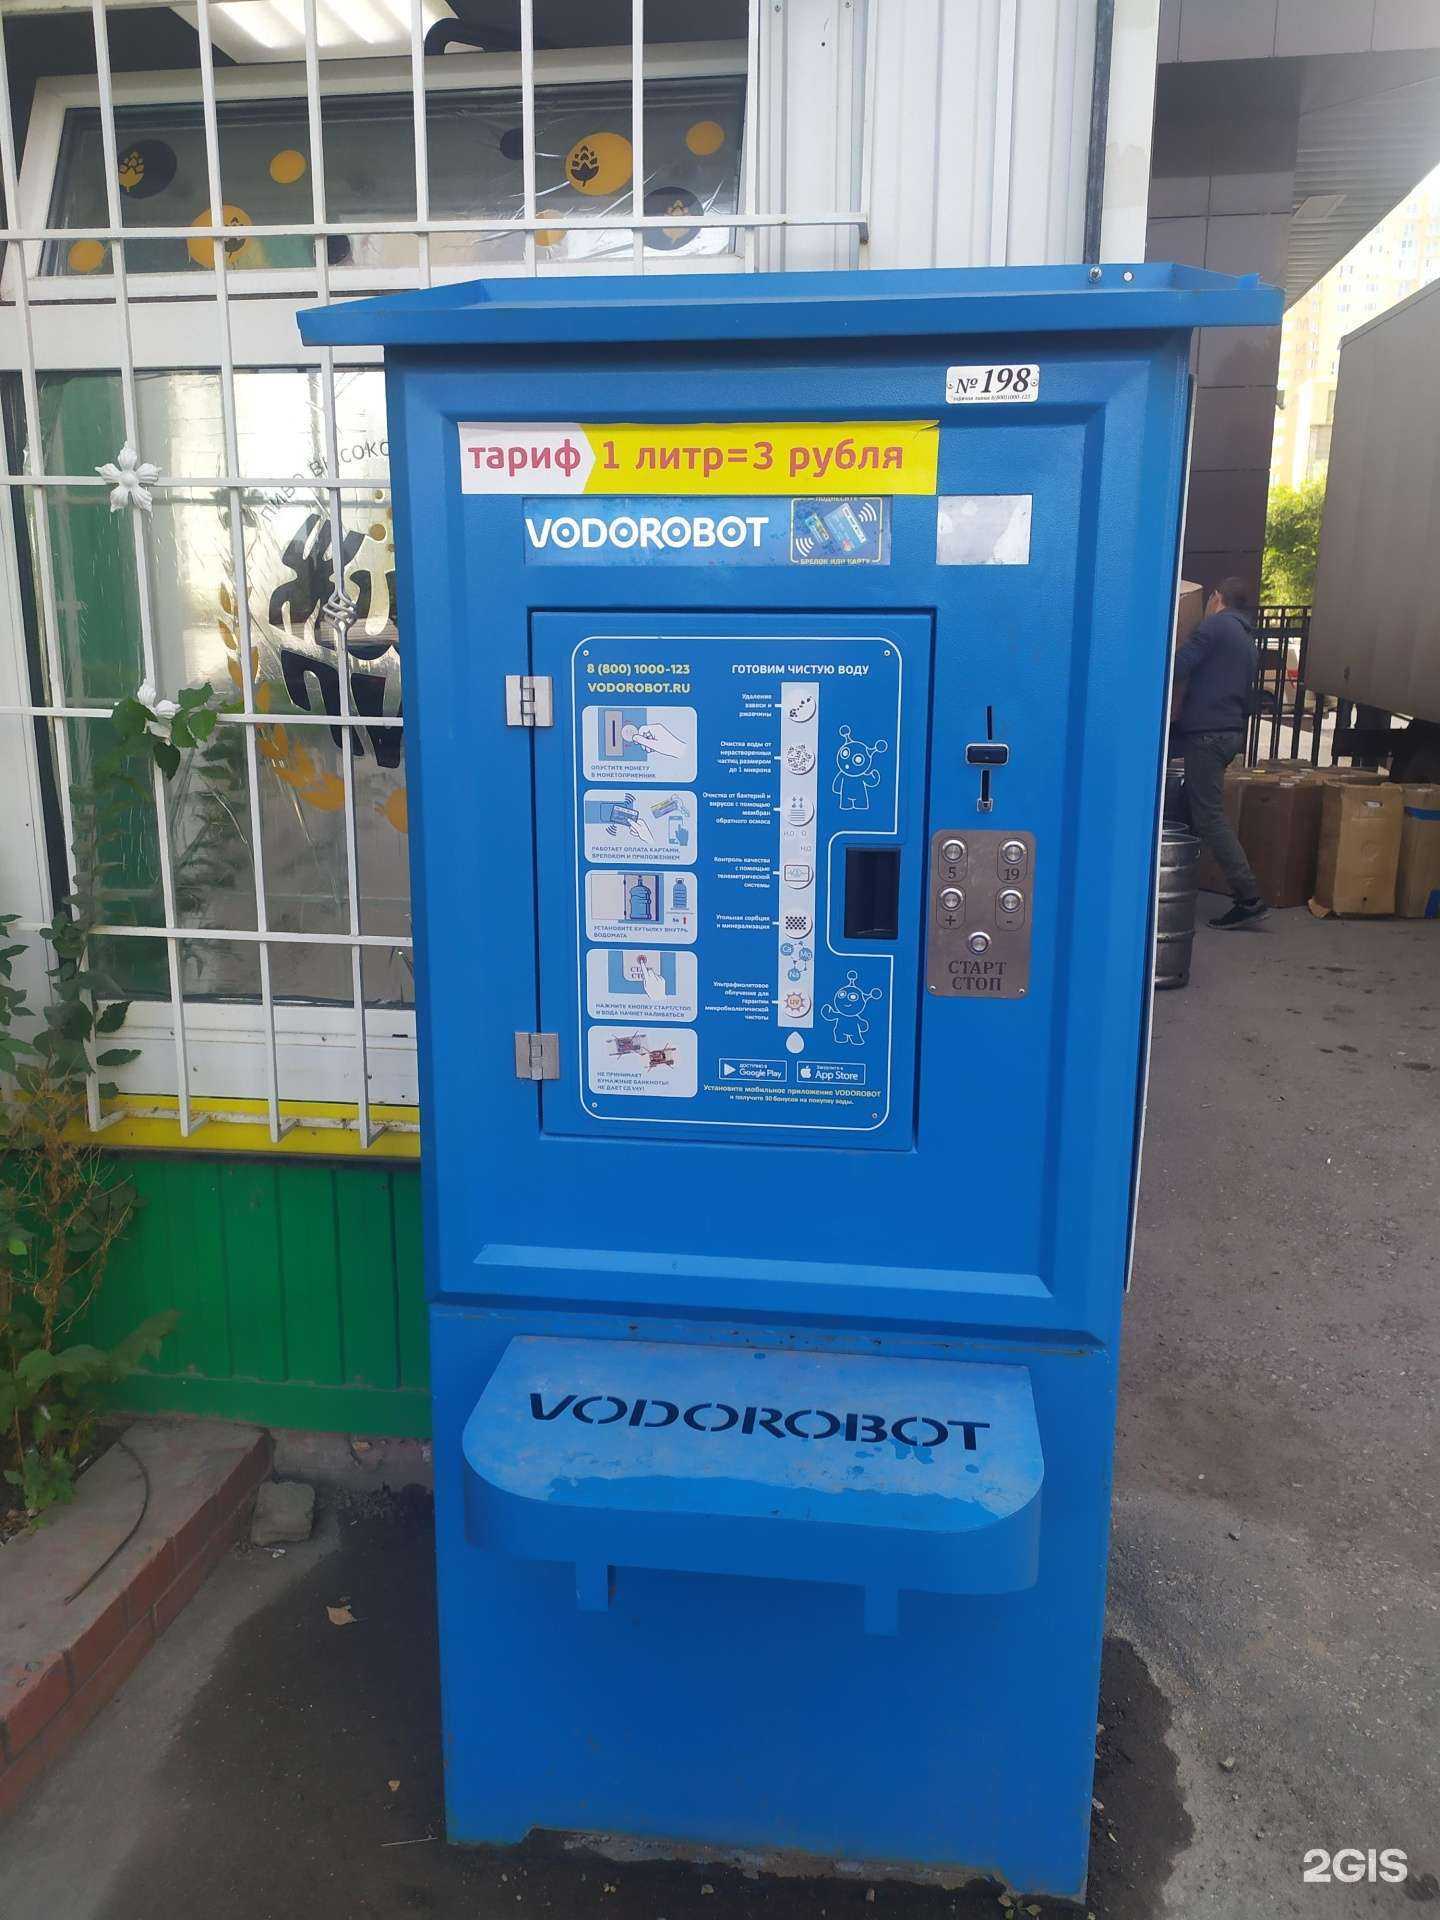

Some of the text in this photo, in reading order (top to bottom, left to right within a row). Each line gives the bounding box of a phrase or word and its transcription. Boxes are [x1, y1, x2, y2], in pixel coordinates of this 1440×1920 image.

[955, 367, 1032, 394] № 198
[467, 438, 581, 477] тариф
[602, 441, 620, 470] 1
[789, 438, 904, 478] рубля
[525, 515, 769, 549] VODOROBOT
[586, 663, 691, 676] 8 (800) 1000-123
[731, 664, 869, 676] ГОТОВИМ ЧИСТУЮ ВОДУ
[587, 682, 691, 693] VODOROBOT.RU
[741, 692, 772, 700] Удаление
[702, 791, 728, 799] Очистка
[736, 792, 766, 800] бактерий
[716, 817, 748, 825] обратного
[713, 856, 743, 864] Контроль
[947, 866, 956, 880] 5
[1003, 867, 1020, 881] 19
[715, 913, 743, 921] Угольная
[948, 960, 1008, 976] СТАРТ
[951, 976, 1003, 991] СТОП
[704, 1004, 769, 1012] микробиологической
[739, 1068, 782, 1079] Google Play
[815, 1070, 859, 1081] App Store
[703, 1084, 882, 1098] Установите мобильное приложение VODOROBOT
[808, 1098, 834, 1106] покупку
[529, 1392, 991, 1451] VODOROBOT
